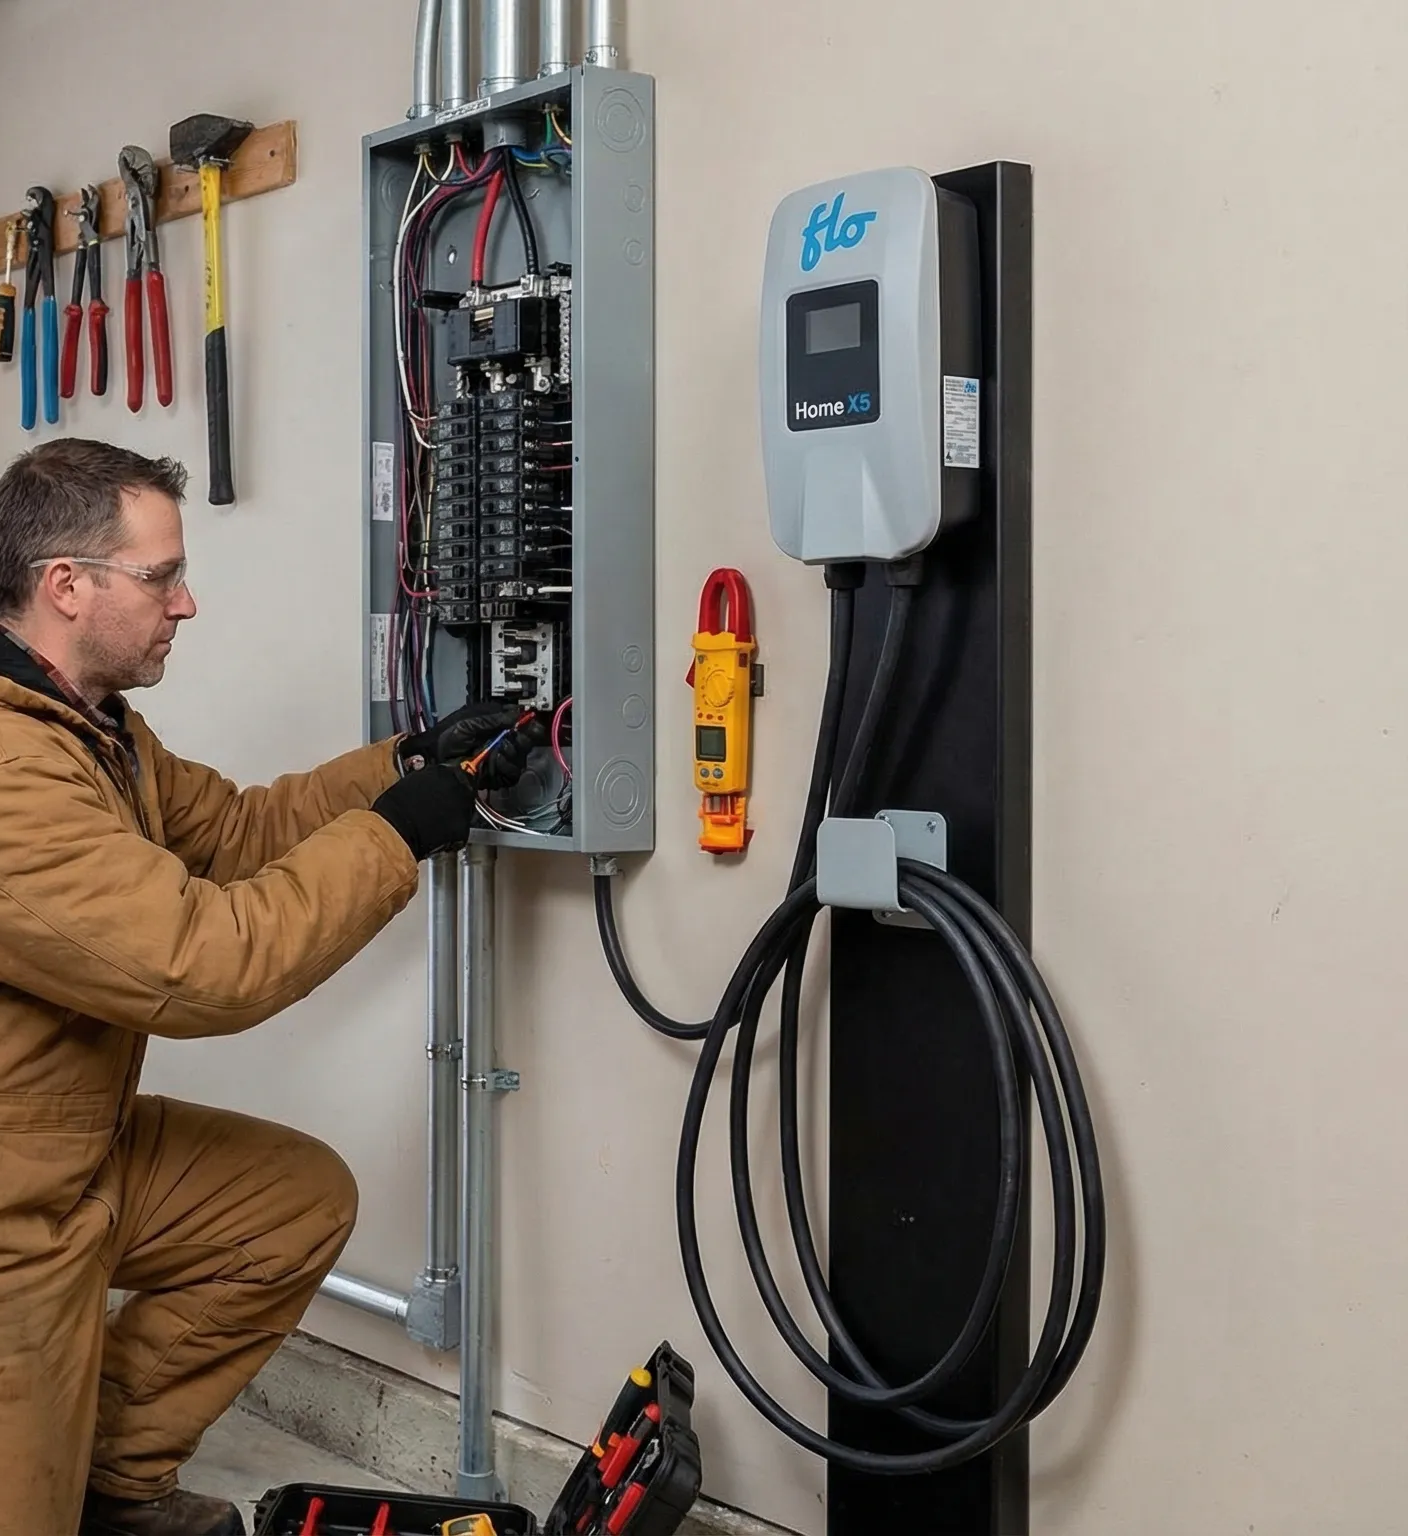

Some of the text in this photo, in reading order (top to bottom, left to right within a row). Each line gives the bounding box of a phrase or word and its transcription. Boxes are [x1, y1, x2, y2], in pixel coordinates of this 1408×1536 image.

[800, 191, 878, 272] flo
[795, 392, 872, 421] Home X5
